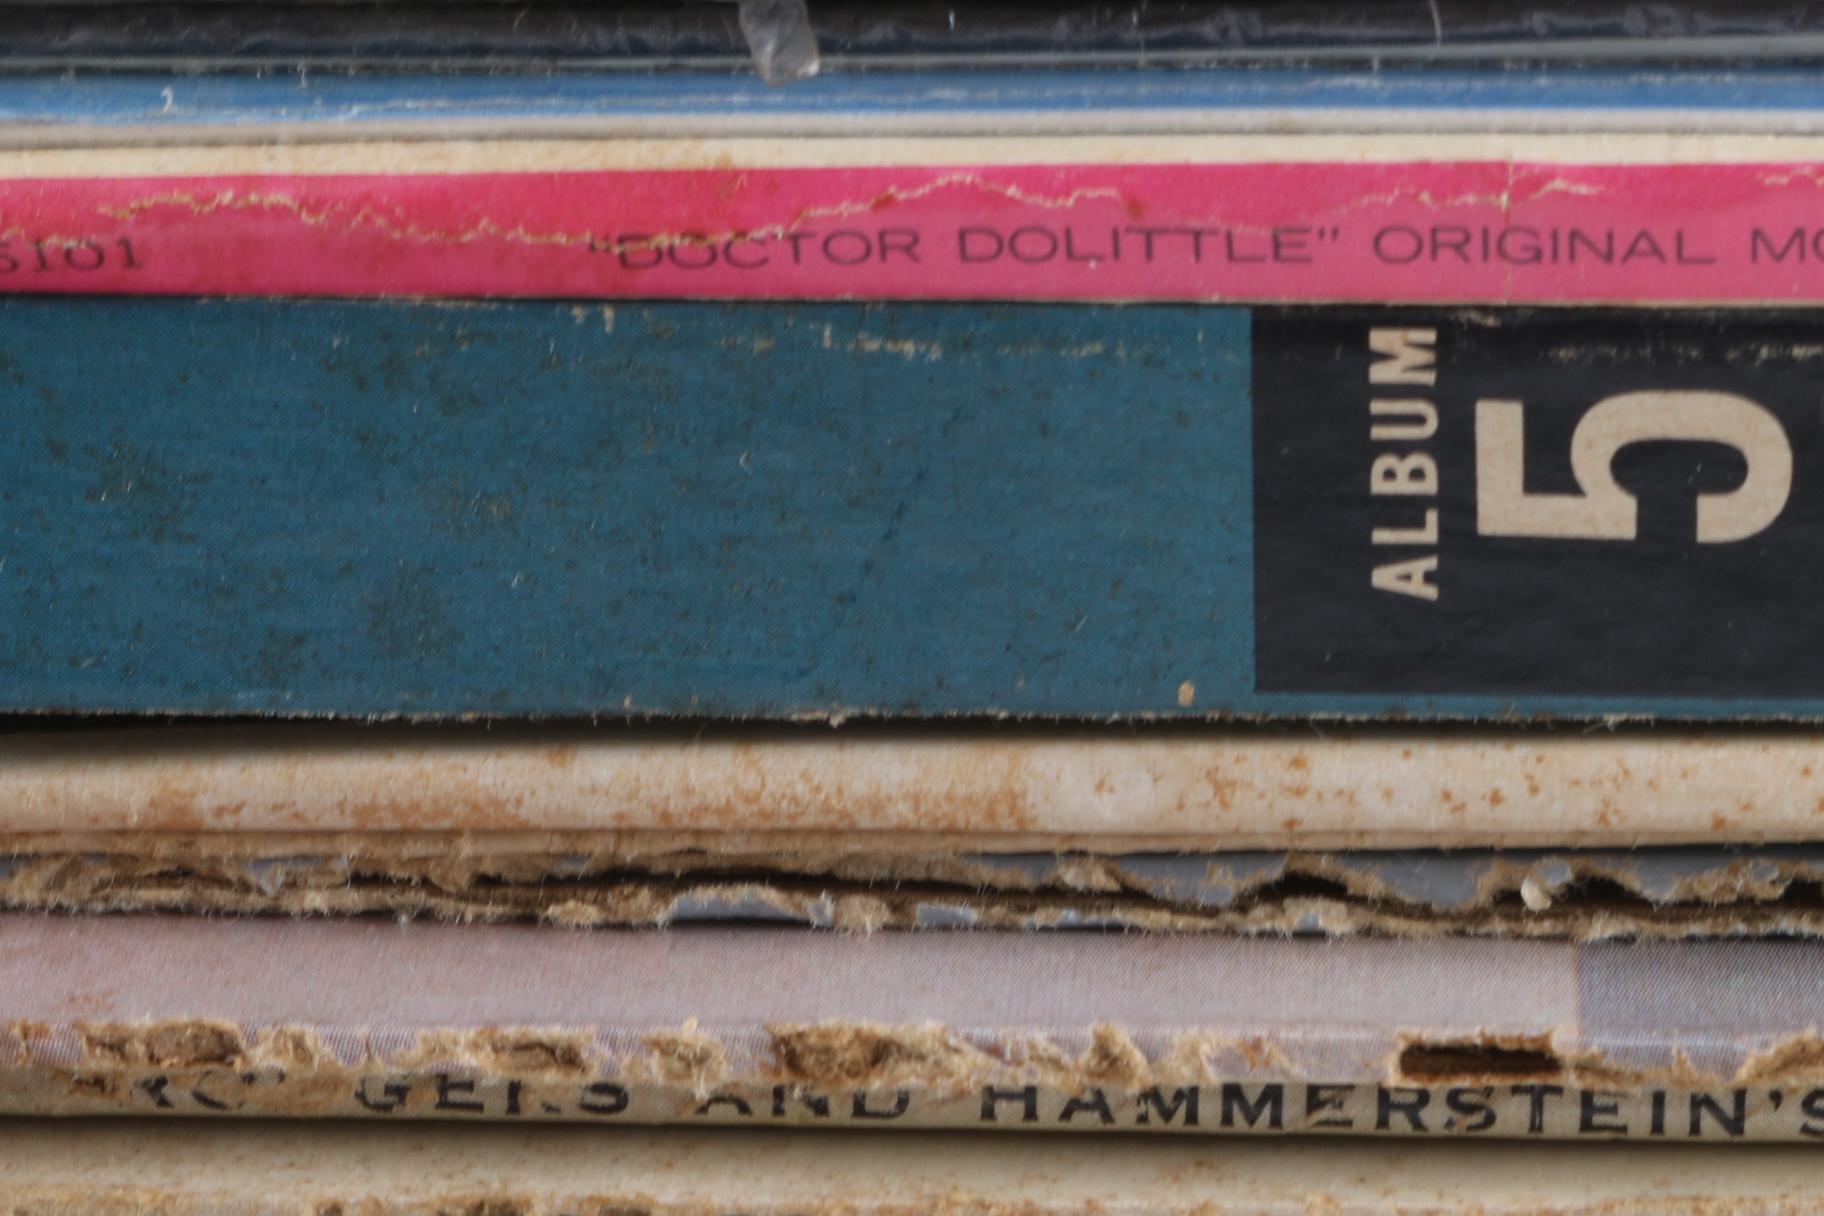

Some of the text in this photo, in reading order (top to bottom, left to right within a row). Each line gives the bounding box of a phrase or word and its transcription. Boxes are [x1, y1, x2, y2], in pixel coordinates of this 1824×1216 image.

[1372, 224, 1717, 265] ORIGINAL
[1369, 327, 1439, 601] ALBUM
[1475, 389, 1793, 544] 5
